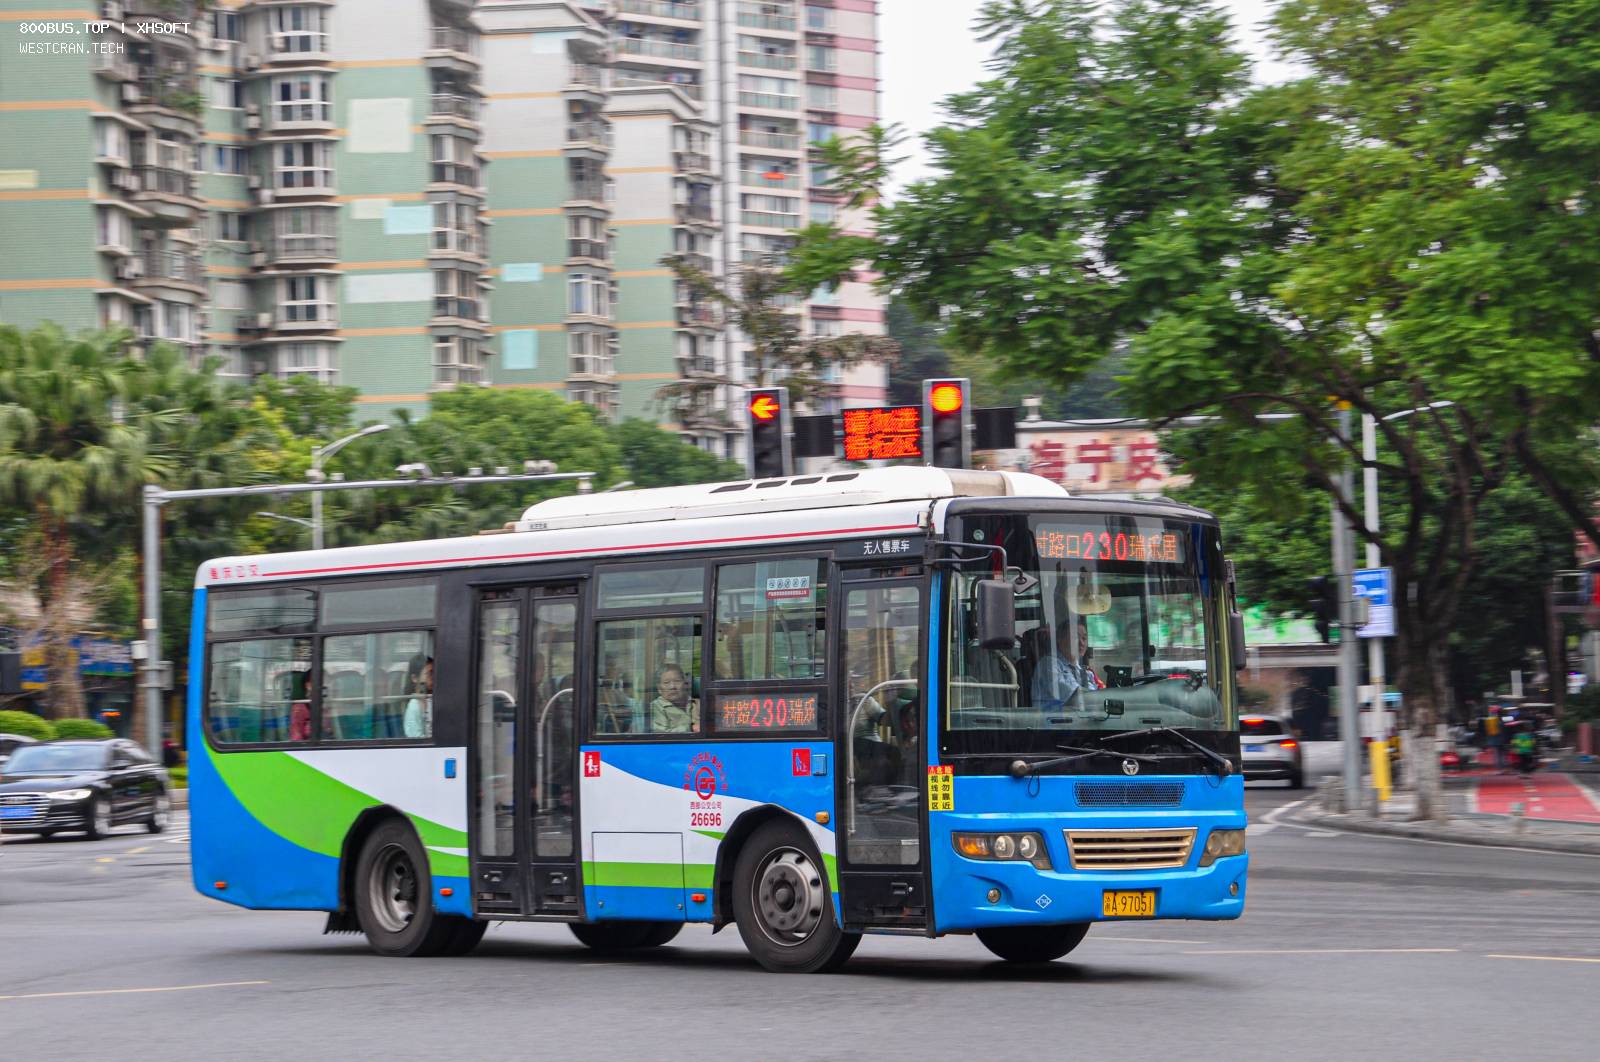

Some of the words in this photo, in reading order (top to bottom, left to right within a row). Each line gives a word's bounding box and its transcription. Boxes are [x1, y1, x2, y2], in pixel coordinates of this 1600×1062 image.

[863, 539, 910, 555] 无人售票车
[1082, 531, 1128, 560] 230
[750, 697, 787, 727] 230
[690, 812, 722, 826] 26696
